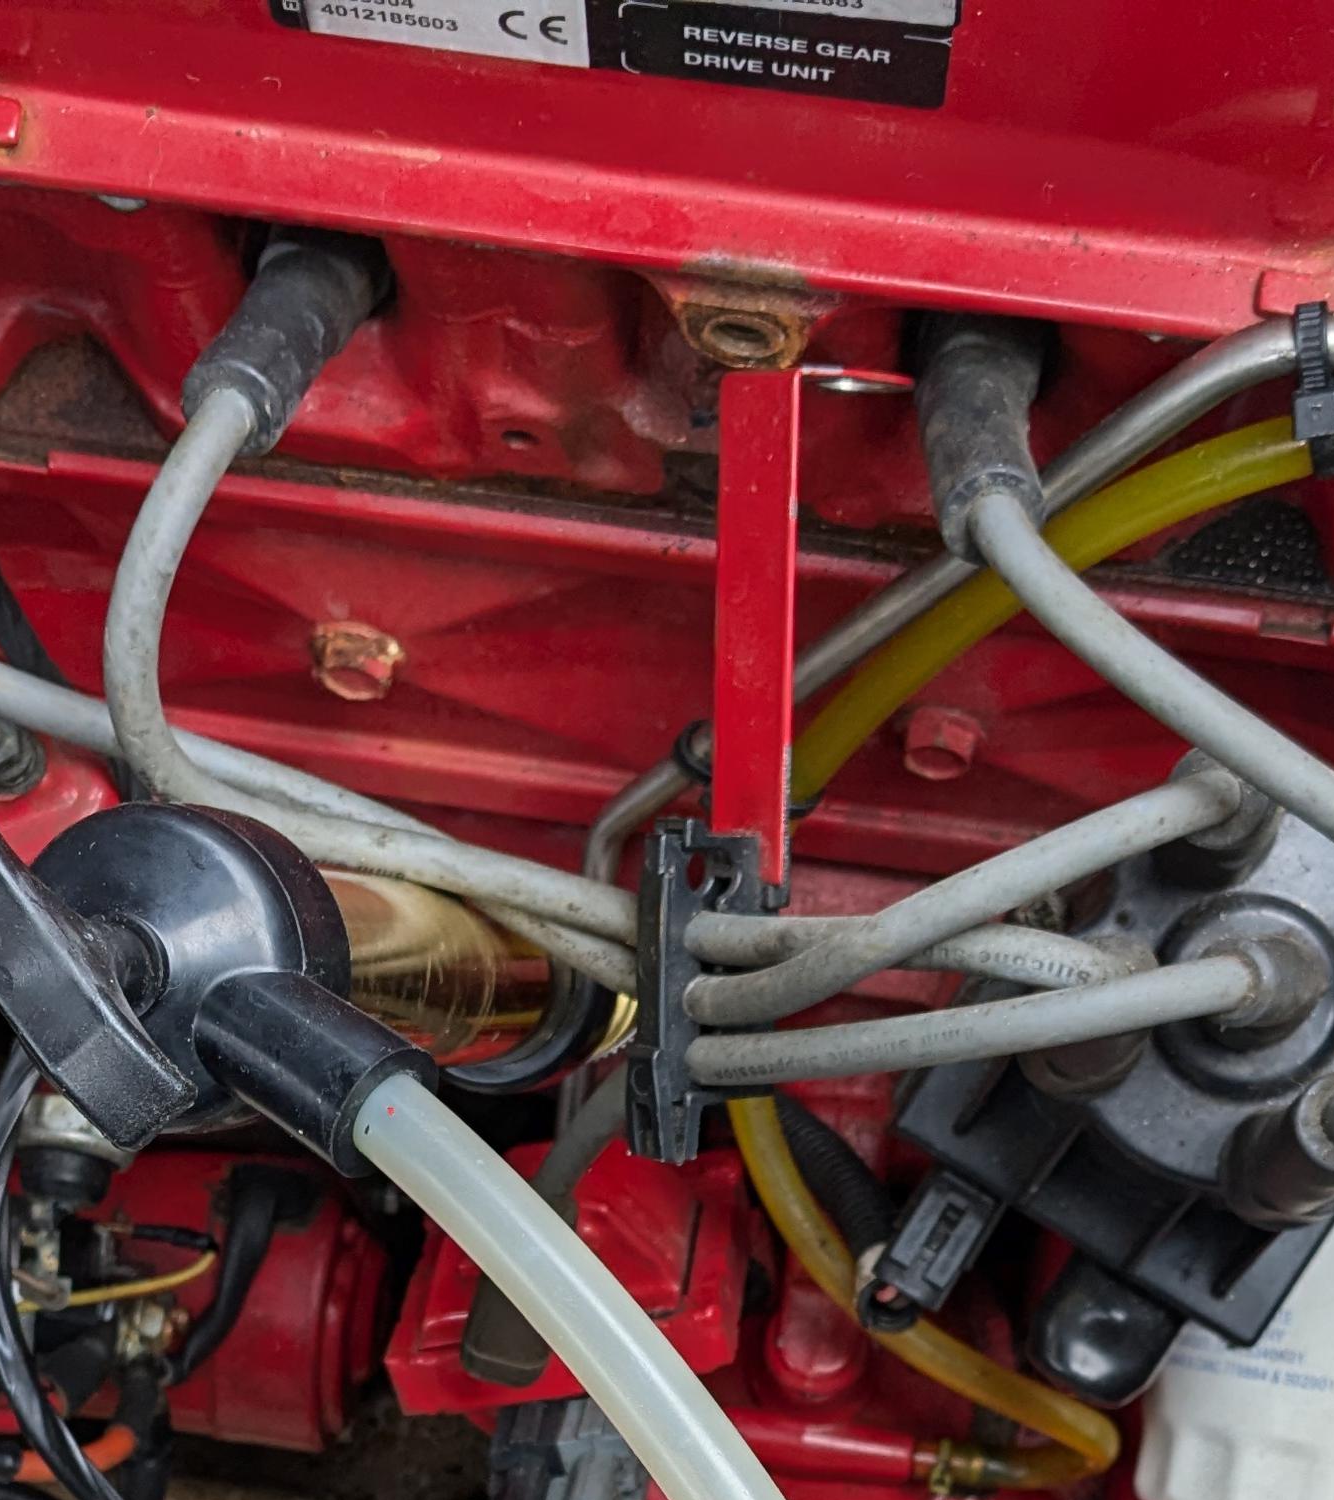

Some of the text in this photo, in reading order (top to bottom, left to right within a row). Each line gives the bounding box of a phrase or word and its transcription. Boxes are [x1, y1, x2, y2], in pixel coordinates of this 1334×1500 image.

[320, 3, 459, 32] 4012185603
[683, 25, 892, 64] REVERSE GEAR
[683, 51, 836, 82] DRIVE UNIT
